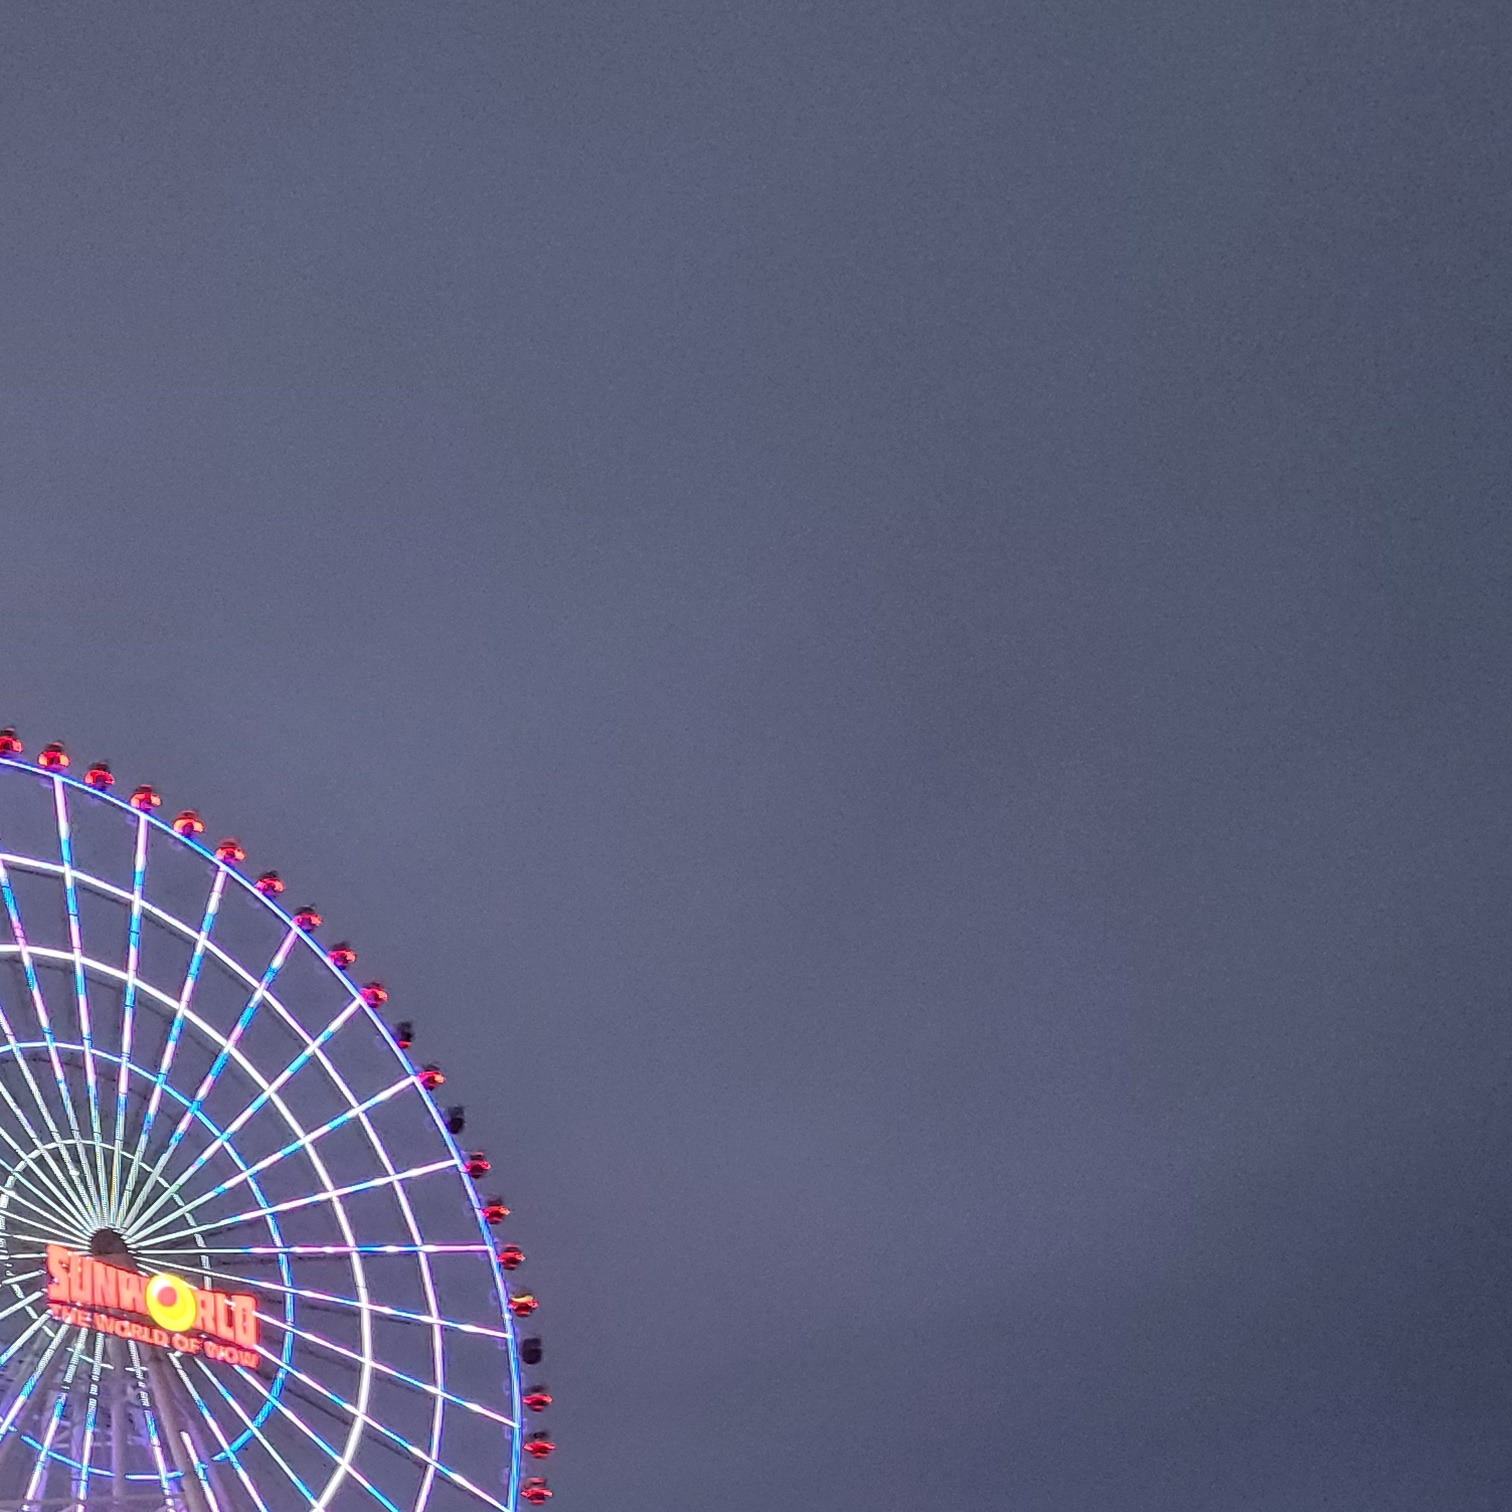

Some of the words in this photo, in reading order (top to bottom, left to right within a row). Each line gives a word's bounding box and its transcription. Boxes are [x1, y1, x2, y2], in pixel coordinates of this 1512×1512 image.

[47, 1304, 92, 1328] THE
[93, 1312, 170, 1347] WORLD
[171, 1333, 202, 1355] OF
[203, 1341, 260, 1369] WOW
